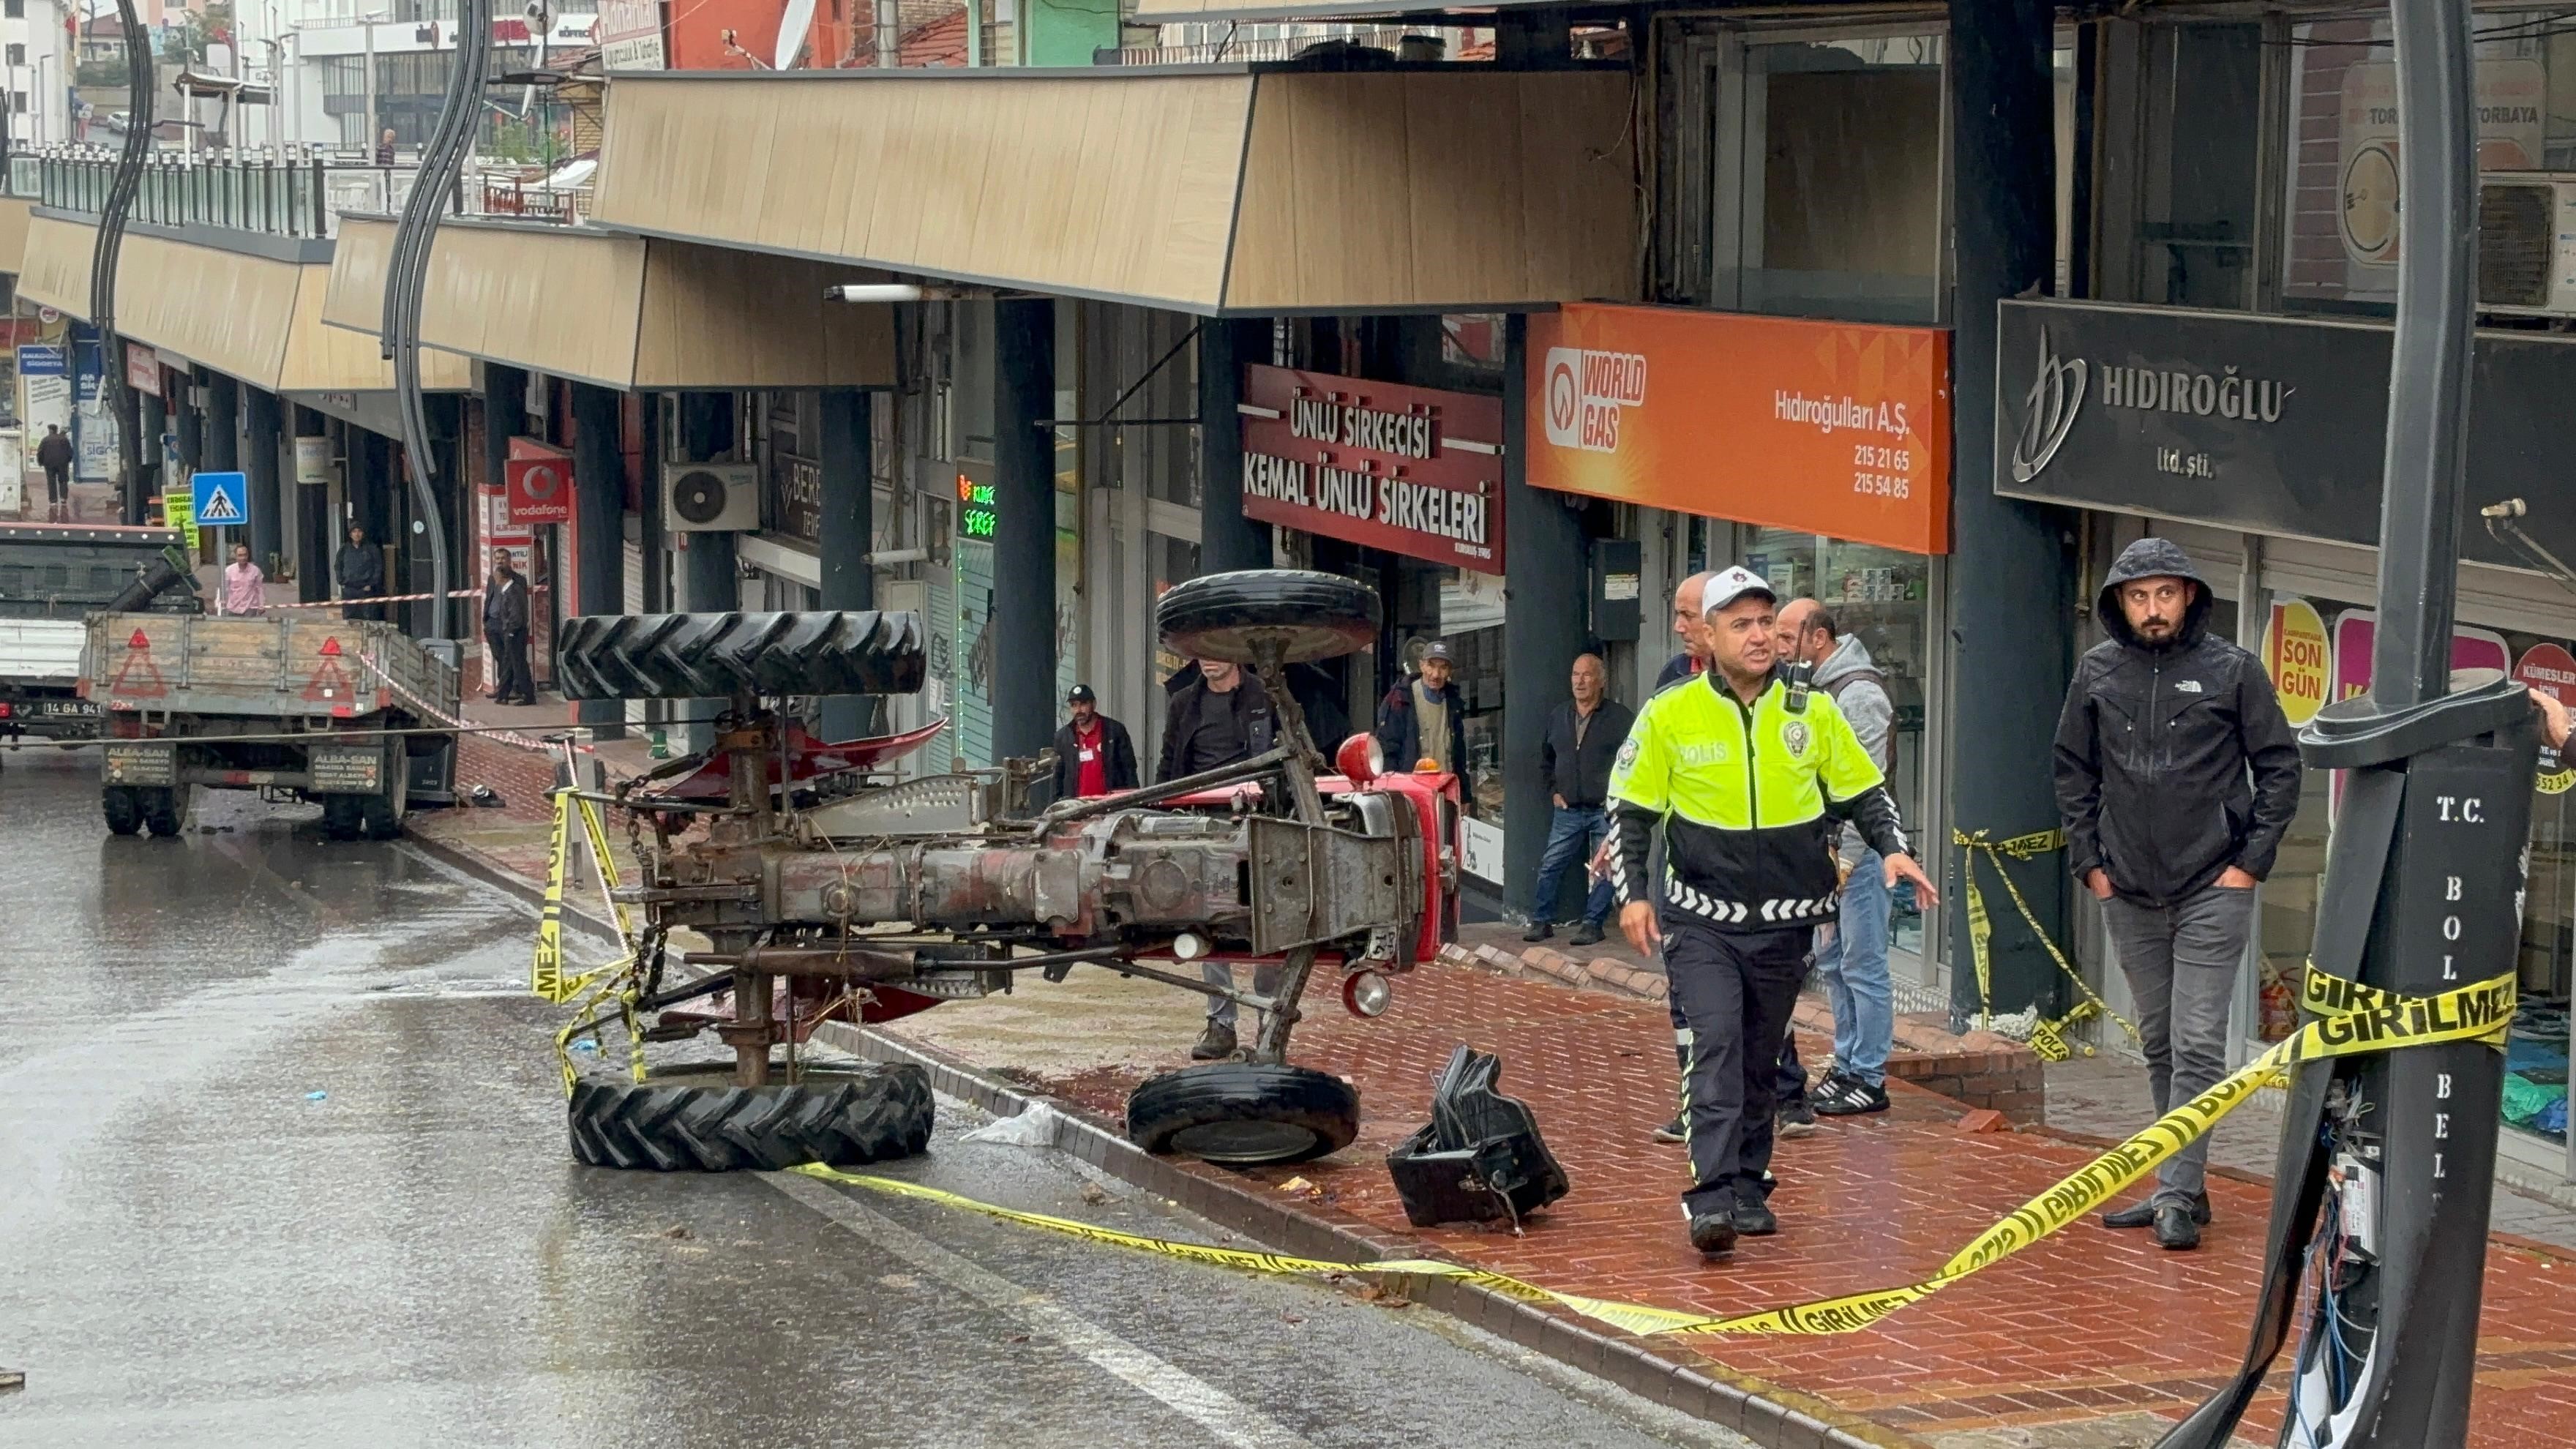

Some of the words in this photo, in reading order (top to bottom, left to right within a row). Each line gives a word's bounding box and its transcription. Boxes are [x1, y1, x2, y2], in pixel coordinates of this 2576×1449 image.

[1583, 353, 1645, 402] WORLD
[2103, 364, 2283, 422] HIDIROĞLU
[1290, 386, 1338, 443] ÜNLÜ
[1344, 396, 1432, 460] SİRKECİSİ
[1584, 404, 1618, 449] GAS
[1876, 402, 1910, 441] A.Ş.
[1855, 445, 1874, 467] 215
[1877, 447, 1891, 468] 21
[1894, 449, 1909, 471] 65
[1244, 452, 1310, 506] KEMAL
[1316, 451, 1372, 520] ÜNLÜ
[1379, 465, 1486, 544] SİRKELERİ
[1854, 473, 1873, 494] 215
[1876, 475, 1891, 497] 54
[1893, 477, 1909, 500] 85
[514, 504, 568, 516] vodafone
[2283, 639, 2321, 669] SON
[2282, 667, 2321, 700] GÜN
[2523, 663, 2576, 685] KÜMESLER
[47, 703, 59, 713] 14
[63, 703, 78, 714] GA
[82, 703, 102, 714] 941
[1678, 741, 1726, 765] POLİS
[2436, 795, 2485, 823] T.C.
[536, 931, 556, 1003] MEZ
